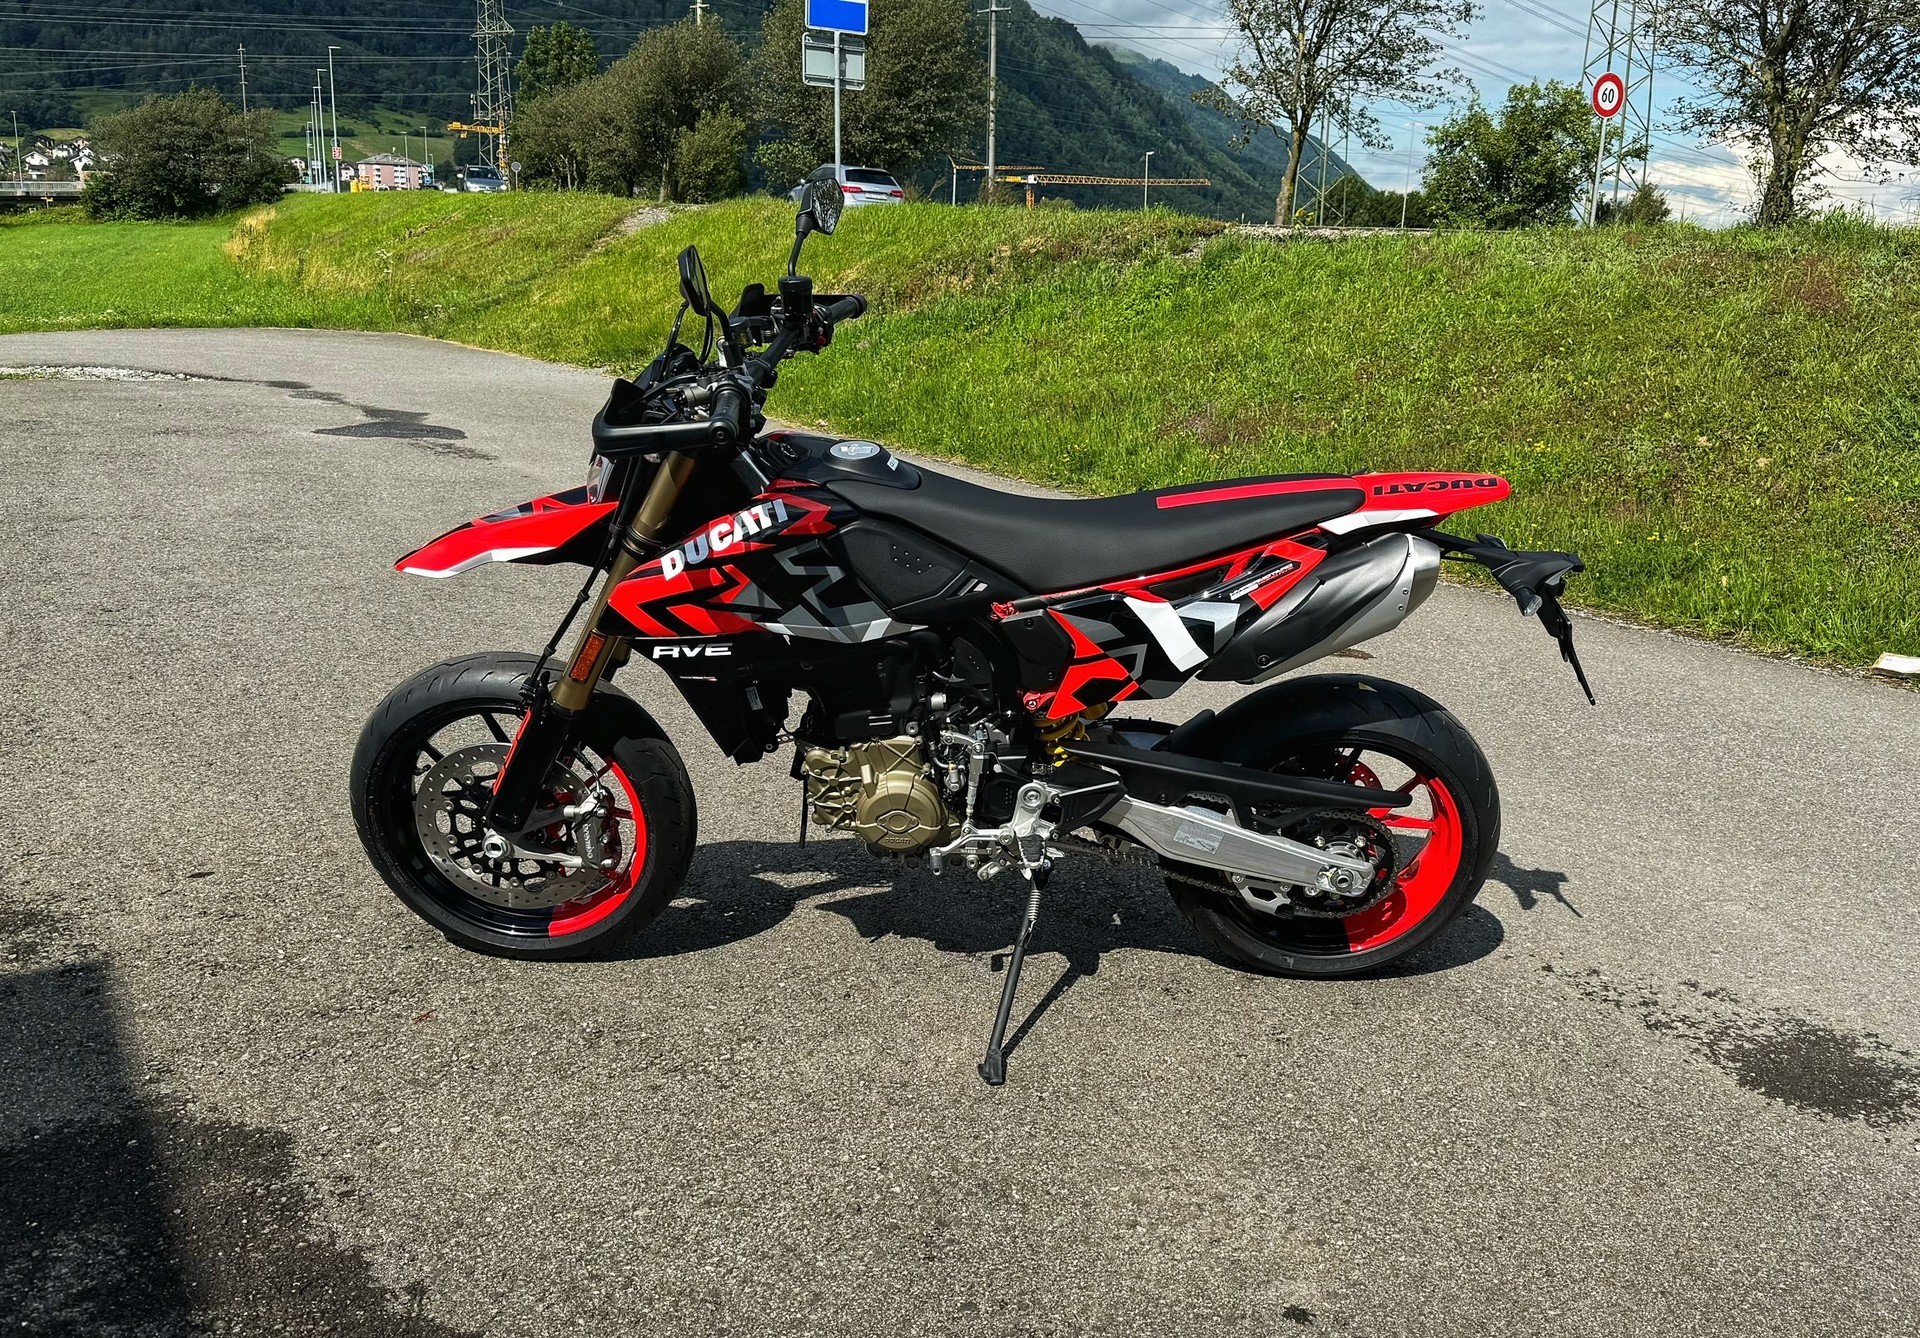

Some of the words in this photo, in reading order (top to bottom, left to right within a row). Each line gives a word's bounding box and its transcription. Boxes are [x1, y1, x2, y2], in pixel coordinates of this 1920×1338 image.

[1601, 87, 1615, 104] 60
[1373, 478, 1498, 496] DUCATI
[660, 498, 788, 581] DUCATI
[652, 642, 733, 659] RVE
